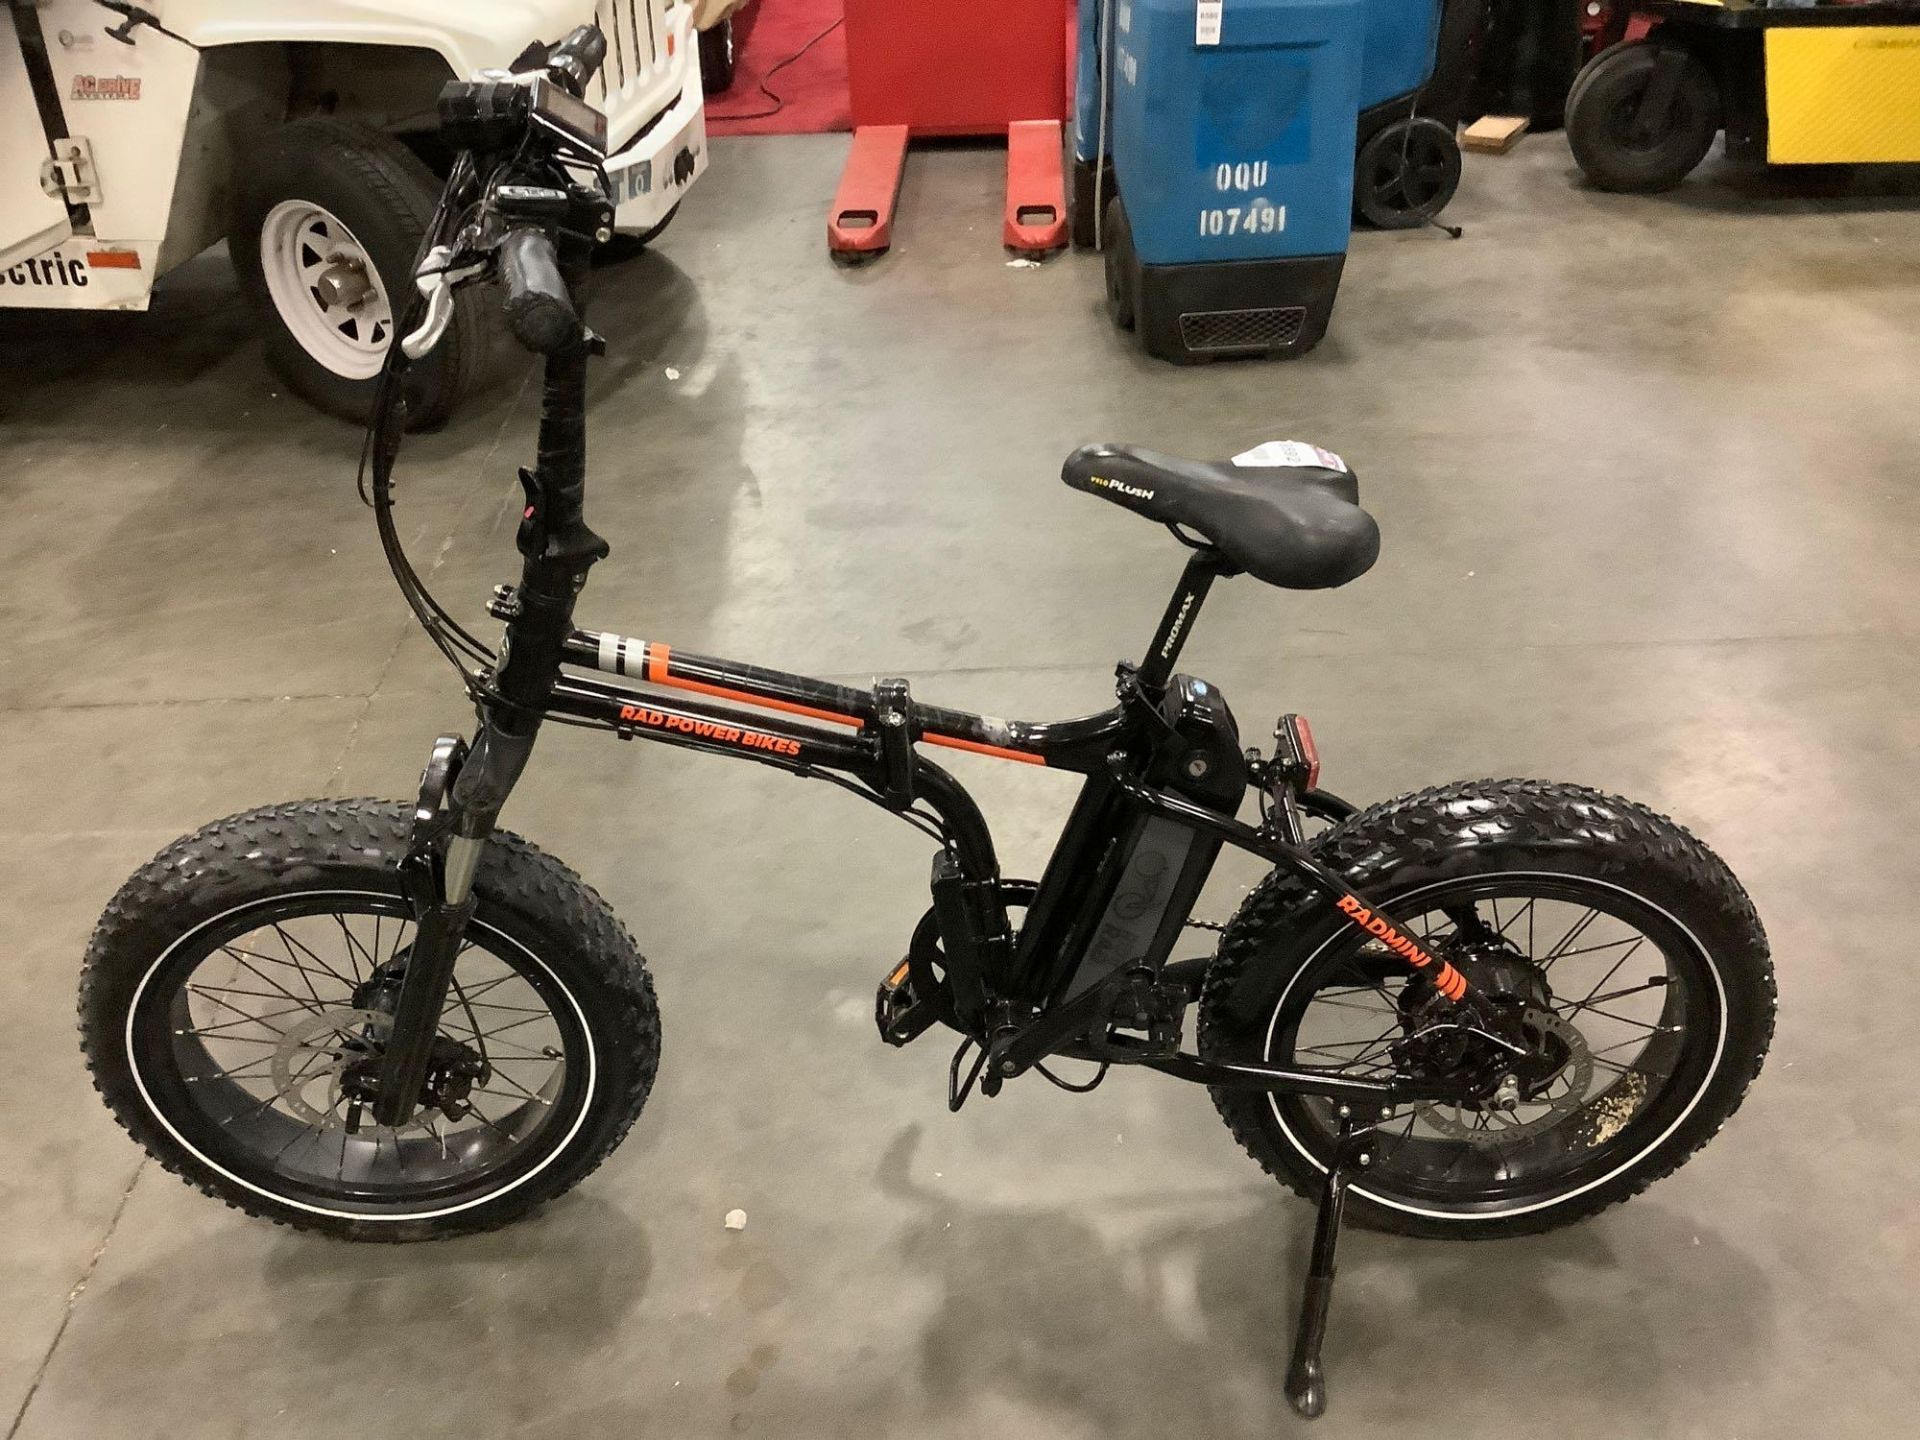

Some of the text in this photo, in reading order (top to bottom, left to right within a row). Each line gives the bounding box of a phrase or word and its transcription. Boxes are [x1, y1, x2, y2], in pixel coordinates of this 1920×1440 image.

[1200, 206, 1286, 236] 107491
[1108, 478, 1155, 500] PLUSH
[1161, 591, 1195, 659] PROMAX
[620, 705, 801, 756] RAD POWER BIKES
[1336, 892, 1432, 967] RADMINI
